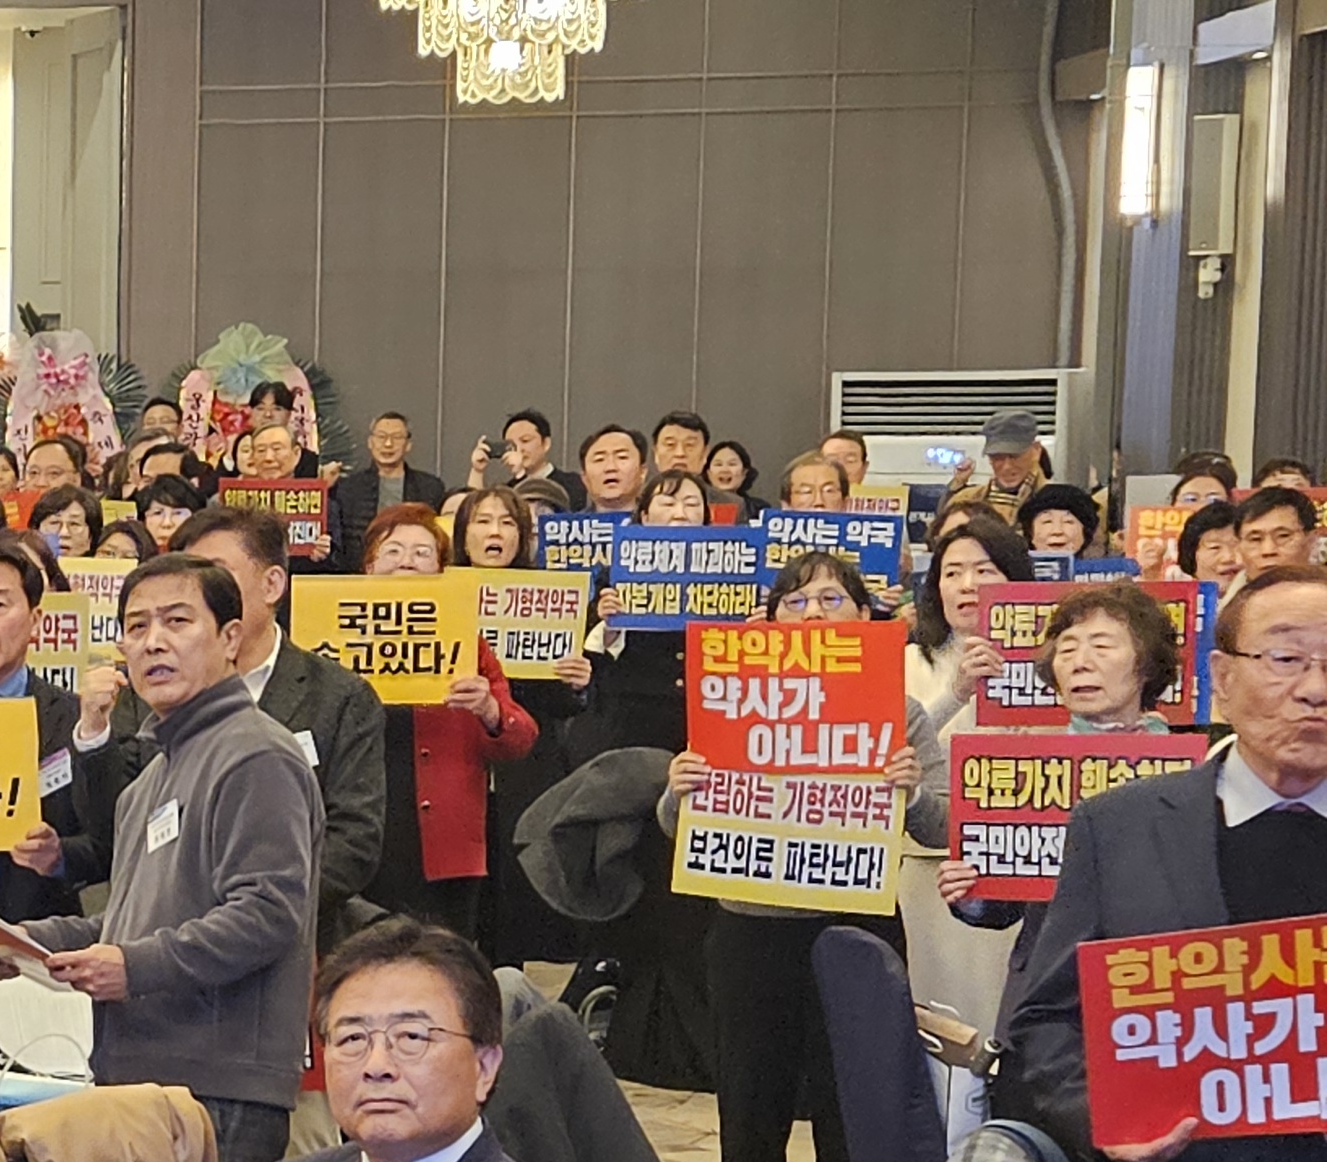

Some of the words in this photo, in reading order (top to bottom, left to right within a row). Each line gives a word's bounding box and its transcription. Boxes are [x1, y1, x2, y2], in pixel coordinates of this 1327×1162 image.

[767, 517, 840, 545] 약사는
[846, 518, 897, 548] 약국
[619, 540, 688, 575] 약료체계
[690, 541, 757, 575] 파괴하는
[337, 600, 438, 636] 국민은
[504, 586, 580, 621] 기형적약국
[686, 583, 757, 617] 차단하라!
[505, 628, 574, 662] 파탄난다!
[700, 628, 863, 673] 한약사는
[699, 675, 826, 721] 약사가
[747, 722, 894, 768] 아니다!
[690, 769, 775, 820] 난립하는
[781, 779, 895, 830] 기형적약국
[963, 756, 1072, 810] 약료가치
[687, 829, 776, 880] 보건의료
[782, 841, 885, 890] 파탄난다!
[961, 823, 1067, 876] 국민안전
[1105, 925, 1327, 1009] 한약사
[1110, 992, 1326, 1069] 약사가
